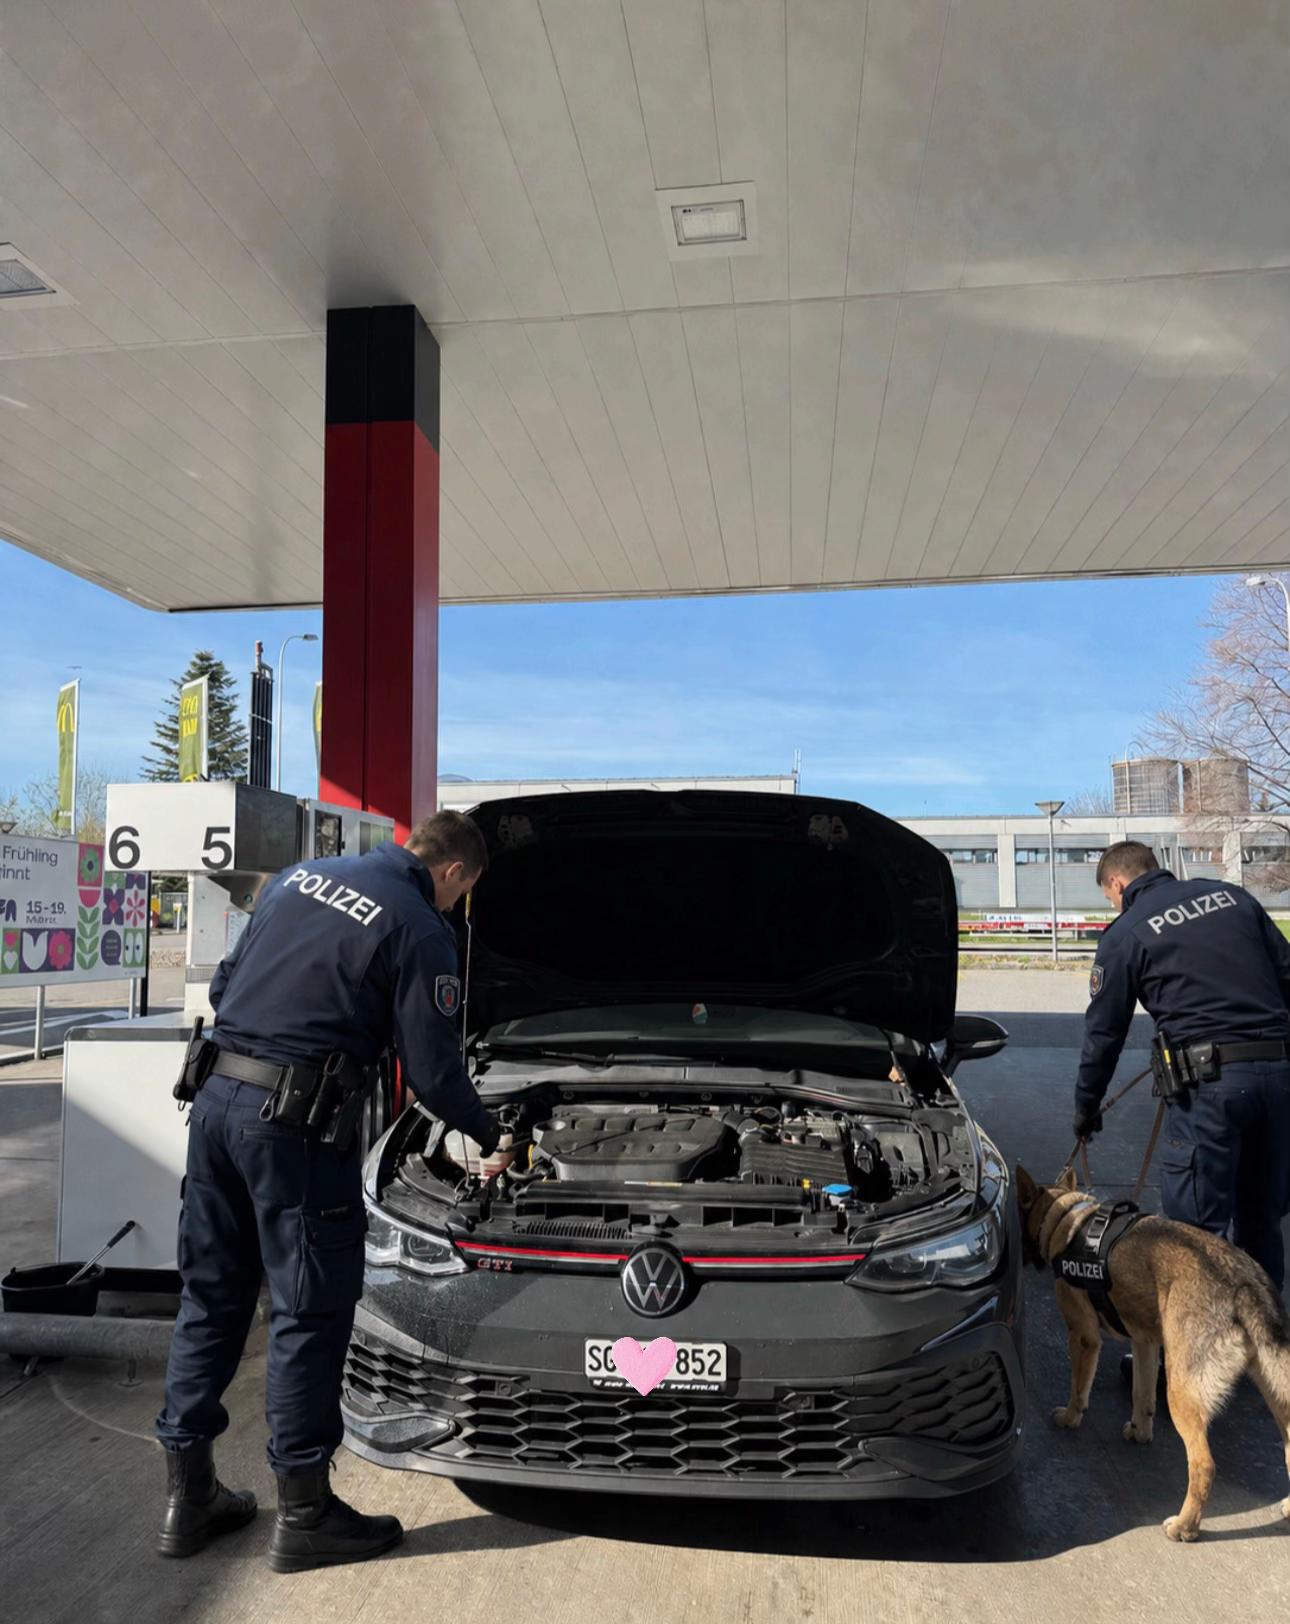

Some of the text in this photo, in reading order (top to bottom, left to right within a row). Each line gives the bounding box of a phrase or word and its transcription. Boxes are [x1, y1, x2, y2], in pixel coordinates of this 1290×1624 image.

[3, 845, 58, 867] Frühling
[108, 825, 233, 870] 6 5
[0, 864, 31, 881] innt
[283, 868, 383, 926] POLIZEI
[1147, 890, 1237, 935] POLIZEI
[477, 1257, 513, 1272] GTI
[1061, 1260, 1104, 1280] POLIZEI
